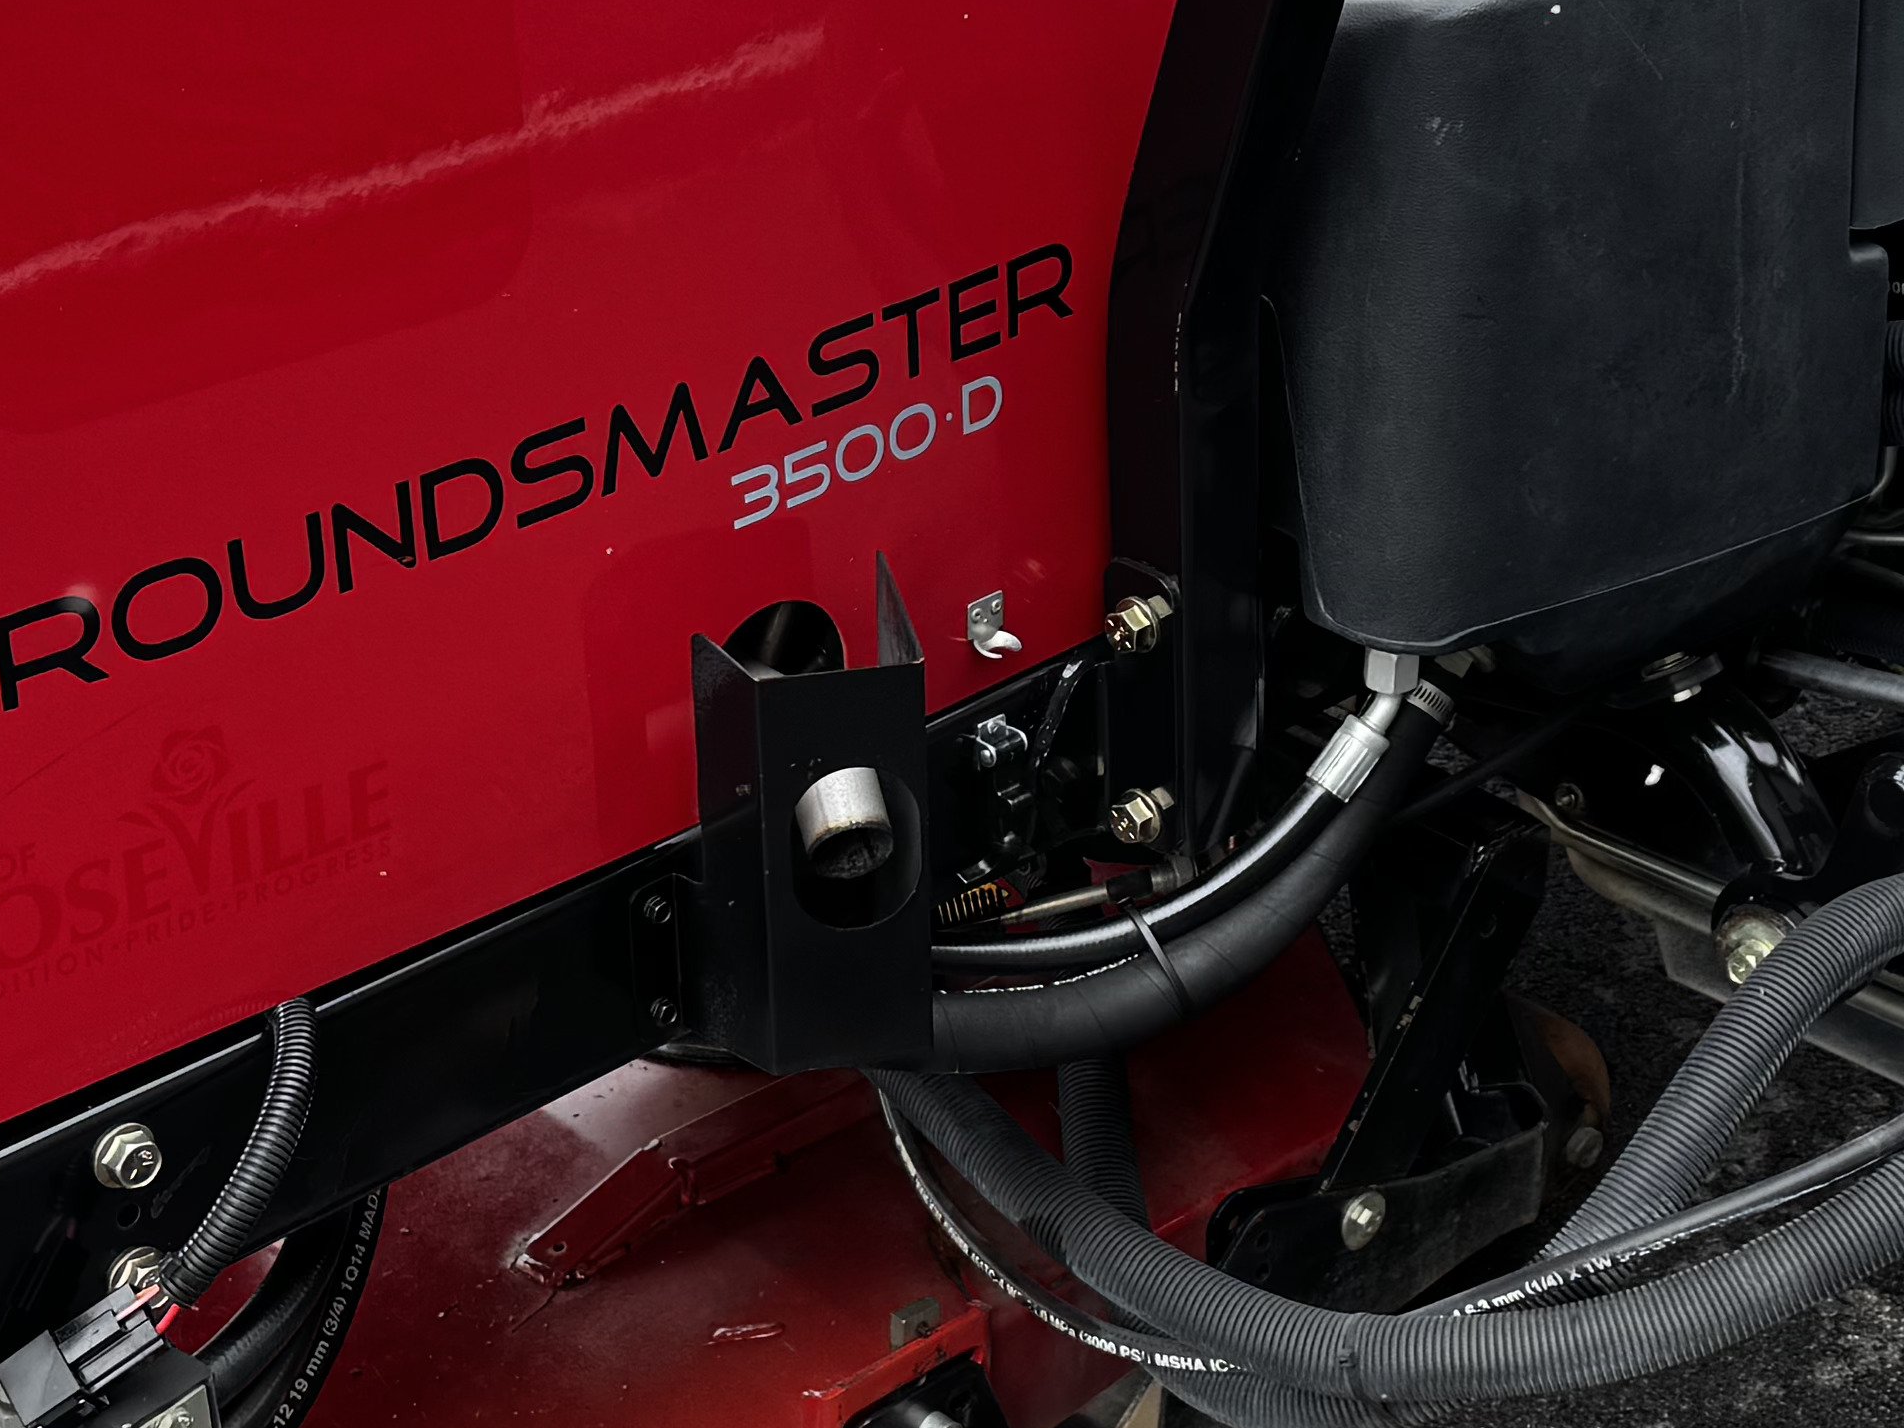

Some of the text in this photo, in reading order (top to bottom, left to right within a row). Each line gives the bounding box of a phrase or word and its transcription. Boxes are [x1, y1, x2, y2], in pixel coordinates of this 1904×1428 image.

[1492, 1288, 1525, 1309] mm
[1524, 1270, 1565, 1296] (1/4)
[289, 1377, 309, 1403] 19
[305, 1339, 331, 1376] mm
[322, 1296, 347, 1337] (3/4)
[1078, 1330, 1117, 1356] (3000
[1154, 1352, 1207, 1372] MSHA
